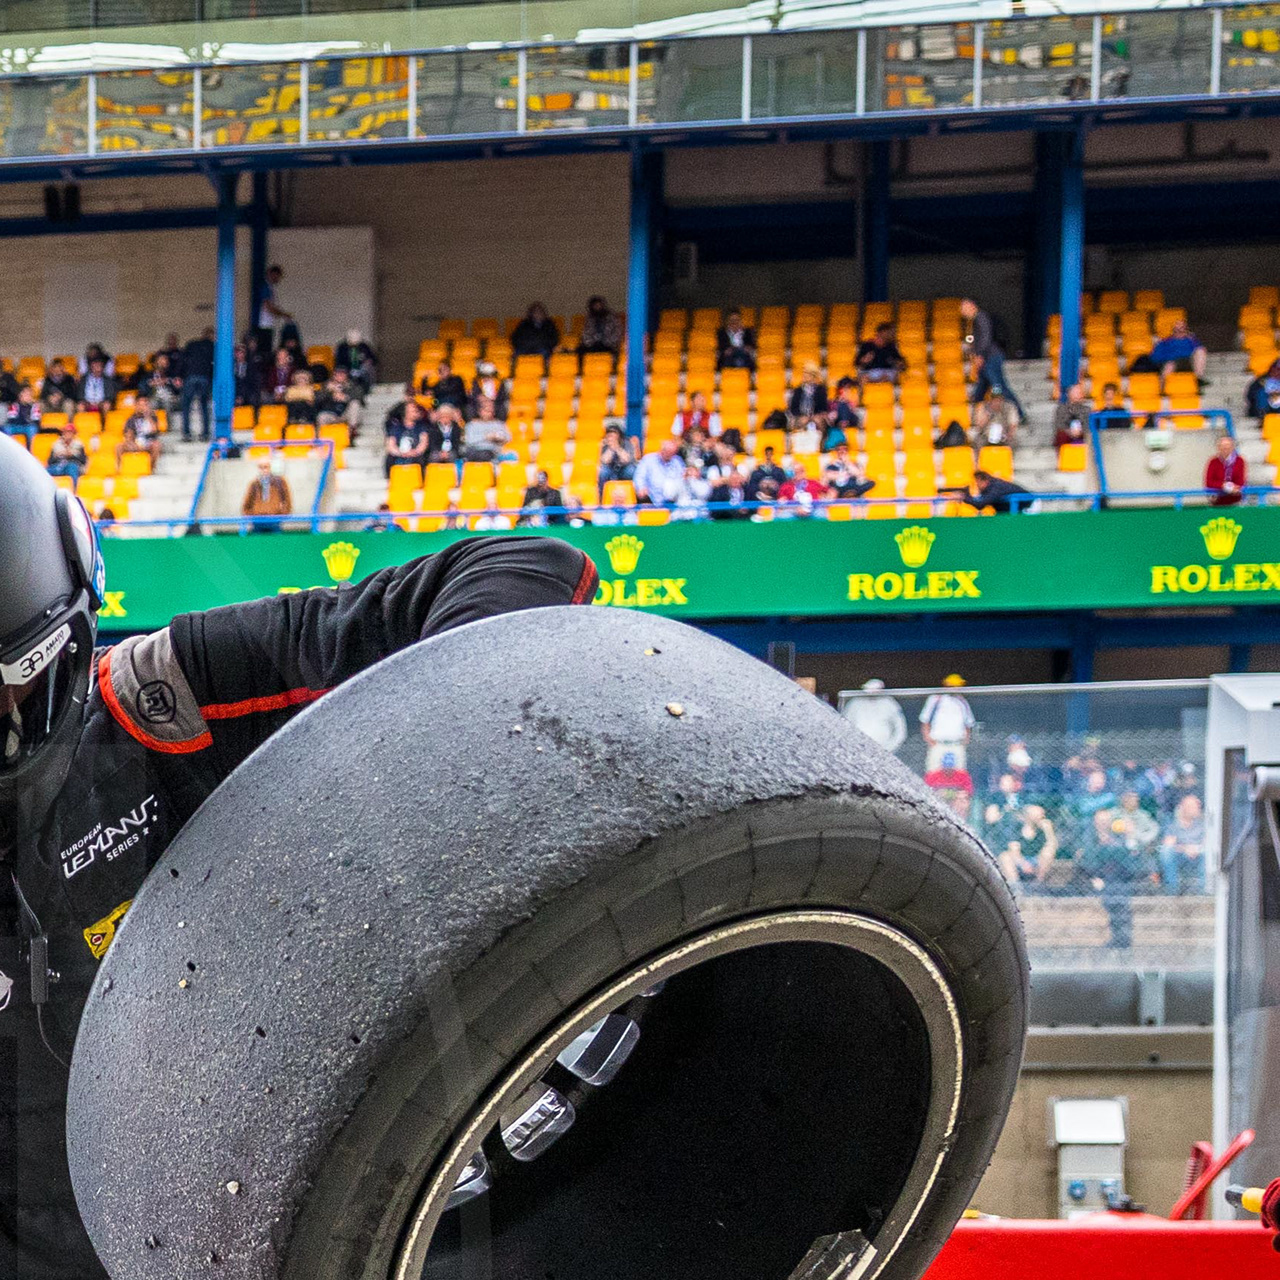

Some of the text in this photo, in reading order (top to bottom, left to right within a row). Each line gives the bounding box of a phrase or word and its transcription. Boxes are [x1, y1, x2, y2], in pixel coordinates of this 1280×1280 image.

[592, 578, 689, 606] OLEX
[847, 570, 981, 600] ROLEX
[1151, 563, 1280, 594] ROLEX
[60, 822, 102, 860] EUROPEAN
[106, 834, 140, 862] SERIES
